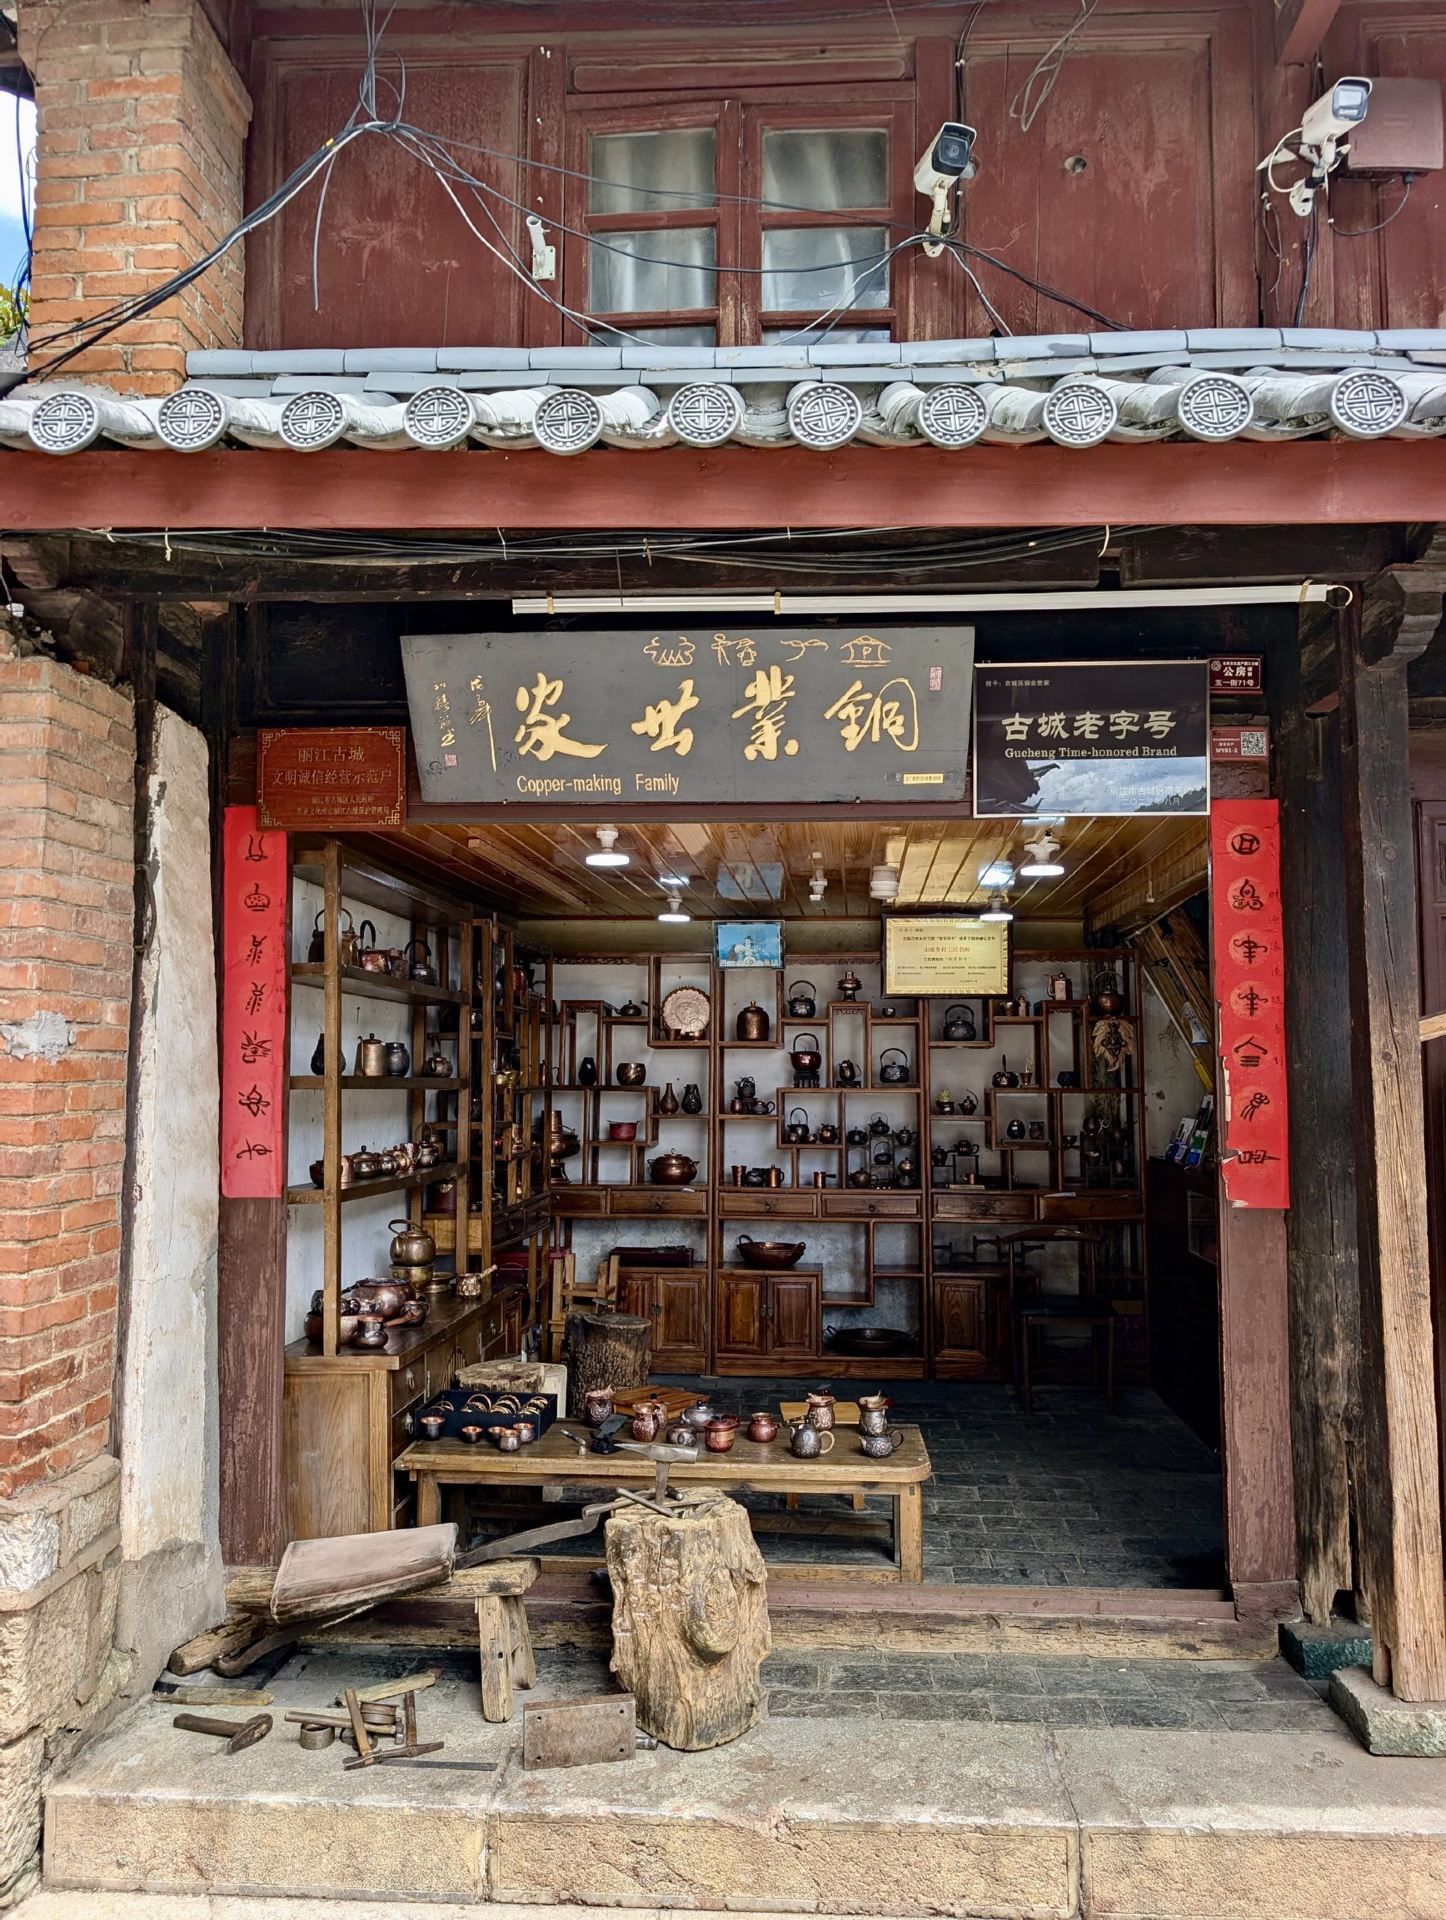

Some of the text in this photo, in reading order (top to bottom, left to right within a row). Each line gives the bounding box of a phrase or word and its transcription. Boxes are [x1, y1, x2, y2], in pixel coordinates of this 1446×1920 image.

[1222, 666, 1246, 677] 公房
[1001, 709, 1177, 741] 古城老字号
[298, 746, 365, 763] 丽江古城
[1005, 745, 1177, 760] Gucheng Time-honored Brand
[272, 769, 393, 785] 文明诚信经营示范户
[516, 772, 680, 797] Copper-making Family
